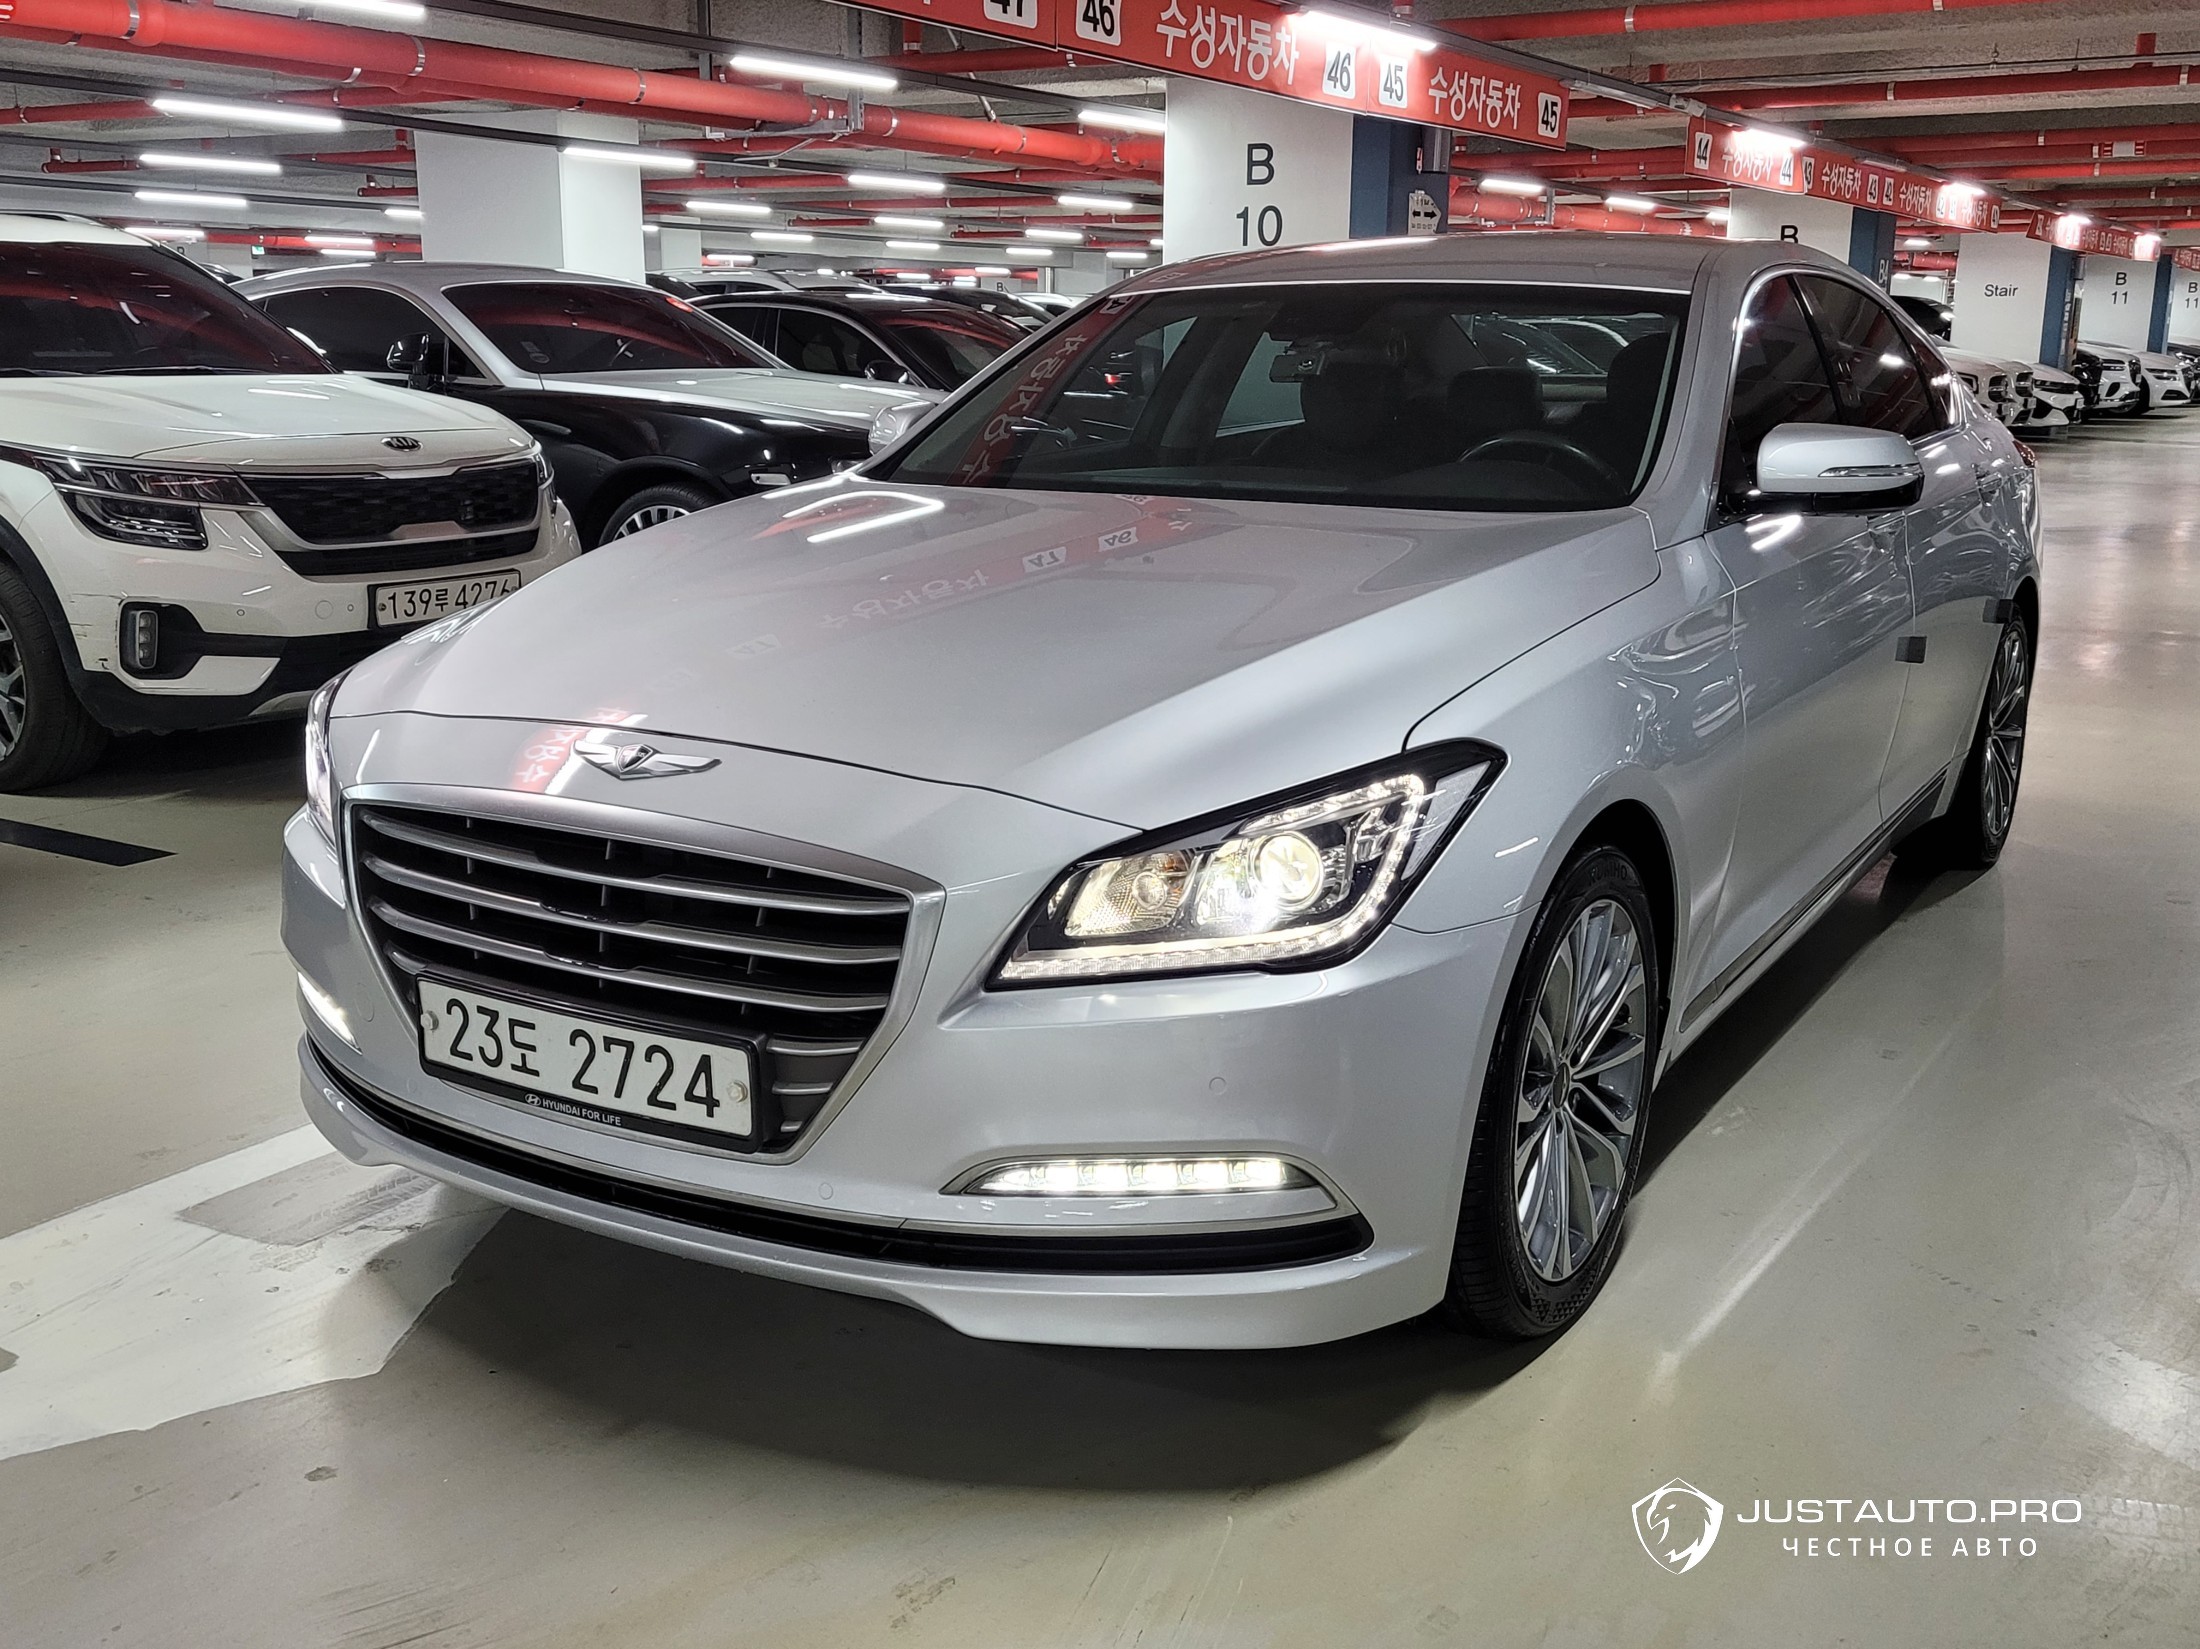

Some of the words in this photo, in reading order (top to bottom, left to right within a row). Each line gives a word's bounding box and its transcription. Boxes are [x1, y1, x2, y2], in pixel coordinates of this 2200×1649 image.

[1082, 0, 1115, 37] 46
[1156, 0, 1300, 86] 수성자동차
[1327, 50, 1351, 93] 46
[1383, 63, 1404, 102] 45
[1428, 66, 1521, 130] 수성자동차
[1541, 101, 1558, 133] 45
[1247, 143, 1275, 185] B
[1697, 138, 1710, 165] 44
[1821, 161, 1862, 200] 수성자동차
[1899, 181, 1933, 215] 수성자동차
[1236, 205, 1283, 247] 10
[1984, 284, 2018, 298] Stair
[2115, 272, 2128, 286] B
[2188, 282, 2198, 293] B
[2111, 291, 2128, 305] 11
[2185, 298, 2199, 309] 11
[390, 436, 419, 448] KIA
[388, 587, 450, 620] 139루
[446, 998, 540, 1077] 23도
[568, 1028, 721, 1118] 2724
[542, 1098, 580, 1117] HYUNDAI
[581, 1108, 600, 1121] FOR
[602, 1113, 621, 1126] LIFE
